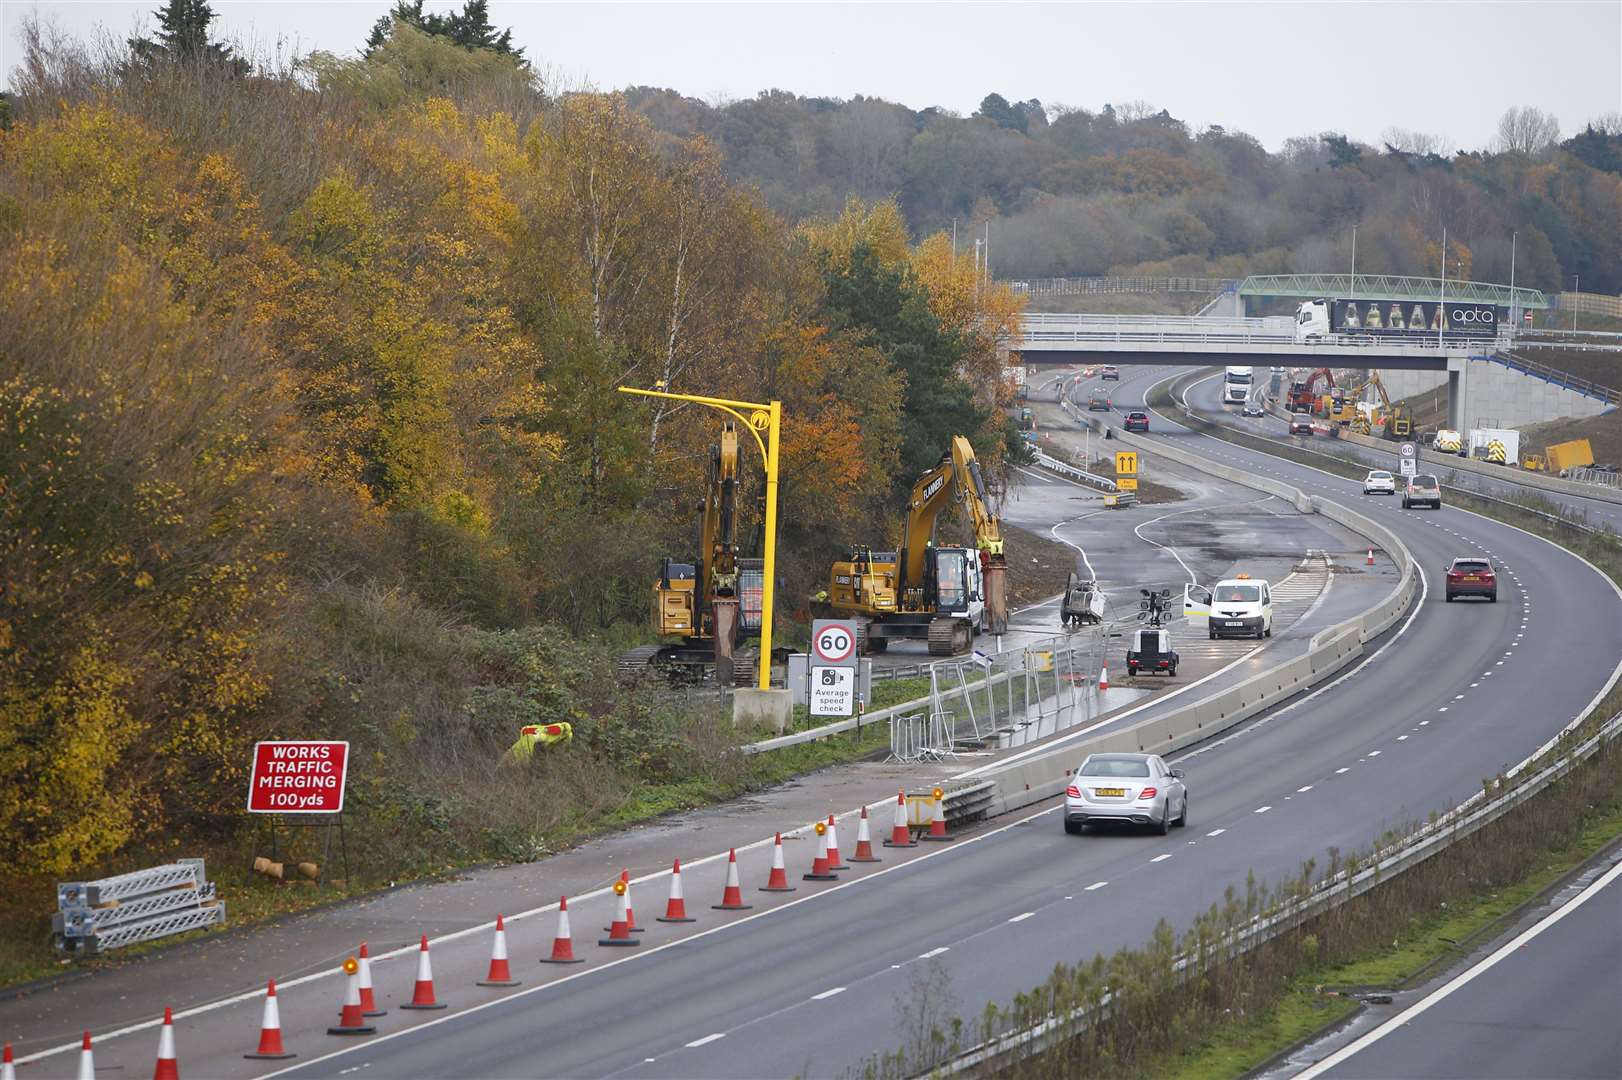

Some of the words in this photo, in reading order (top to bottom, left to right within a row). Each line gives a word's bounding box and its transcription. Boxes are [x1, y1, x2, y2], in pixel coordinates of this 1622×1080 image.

[923, 474, 944, 501] FLANNERY
[820, 635, 848, 650] 60
[815, 689, 849, 697] Average
[272, 746, 330, 759] WORKS
[266, 761, 332, 773] TRAFFIC
[259, 776, 337, 788] MERGING
[269, 793, 297, 806] 100
[298, 793, 324, 808] yds
